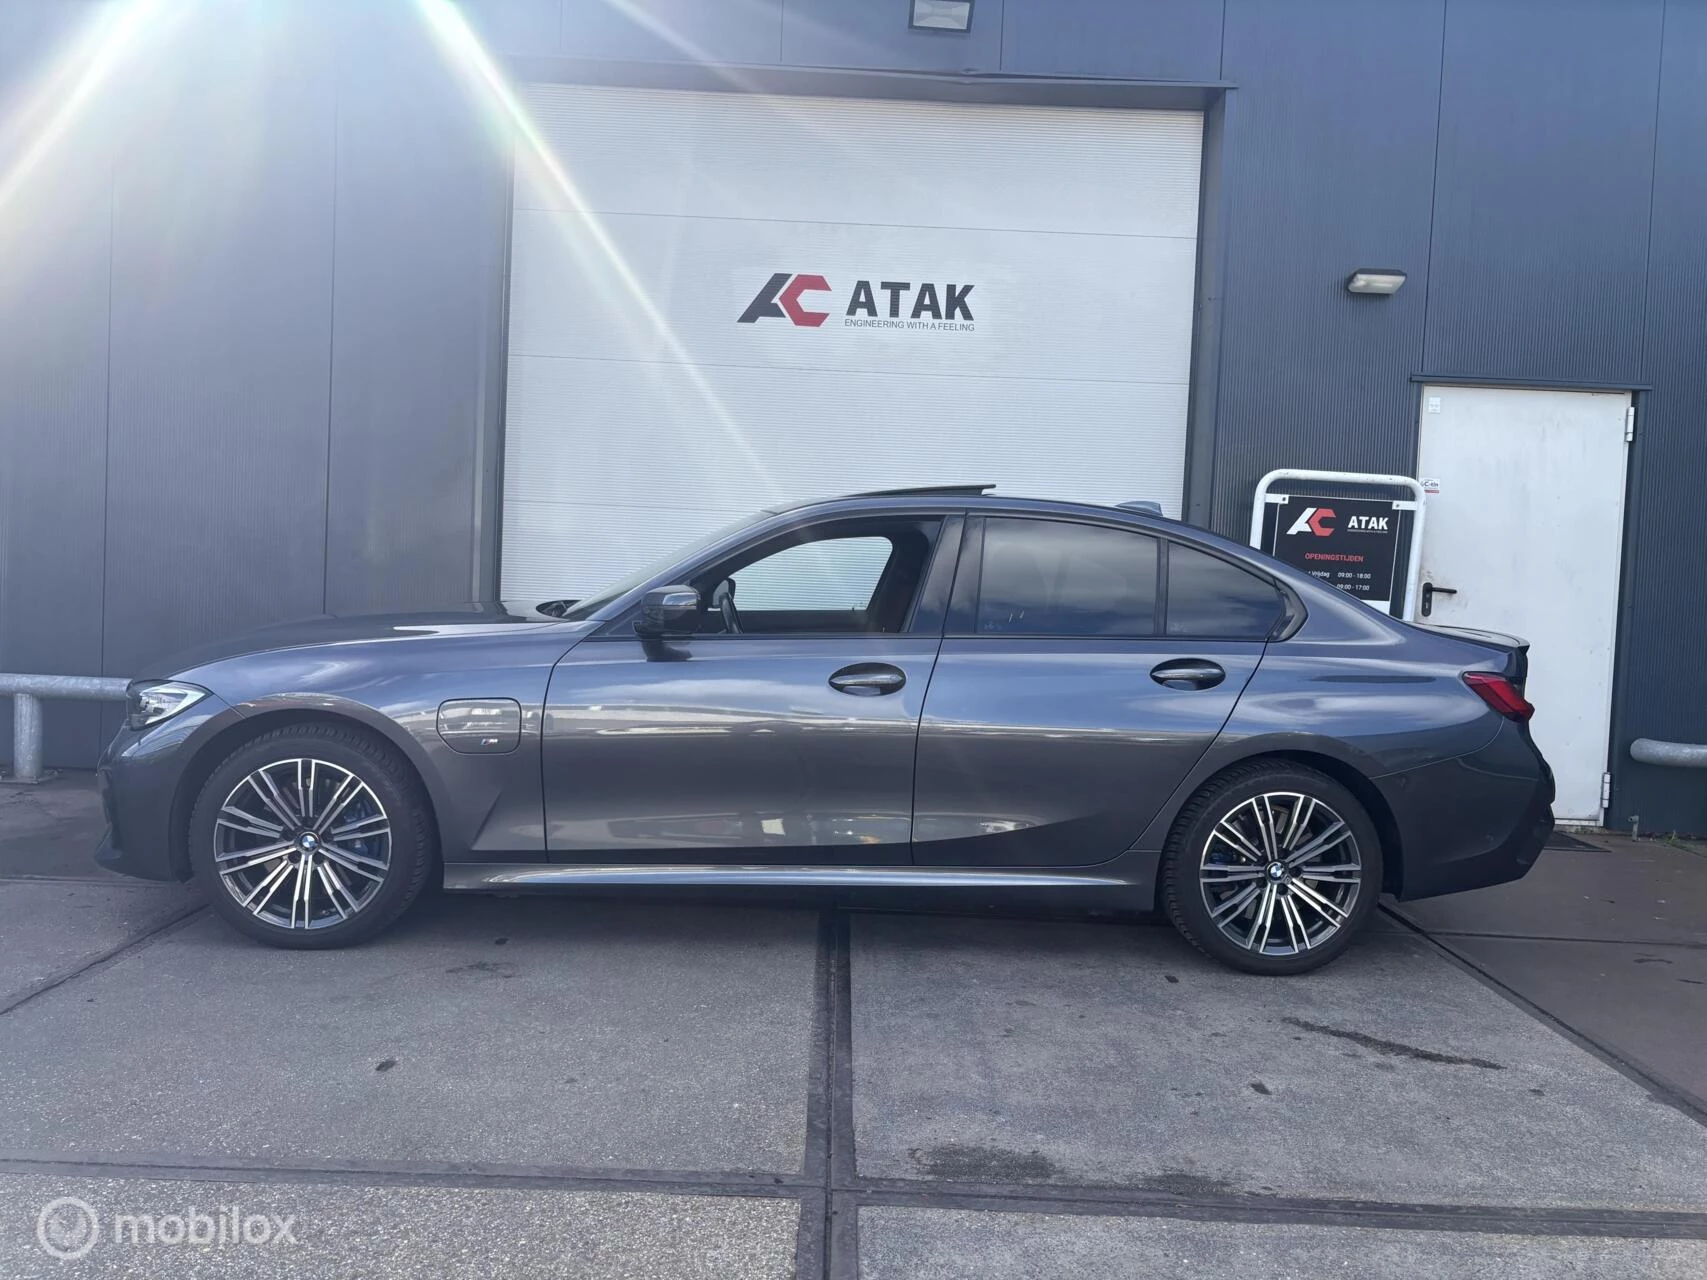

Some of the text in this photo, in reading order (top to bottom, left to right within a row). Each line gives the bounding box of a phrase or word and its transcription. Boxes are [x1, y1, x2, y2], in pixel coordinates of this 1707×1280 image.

[845, 280, 975, 321] ATAK
[844, 319, 975, 332] ENGINEERING WITH A FEELING
[1348, 516, 1389, 530] ATAK
[1305, 553, 1364, 562] OPENINGSTIJDEN
